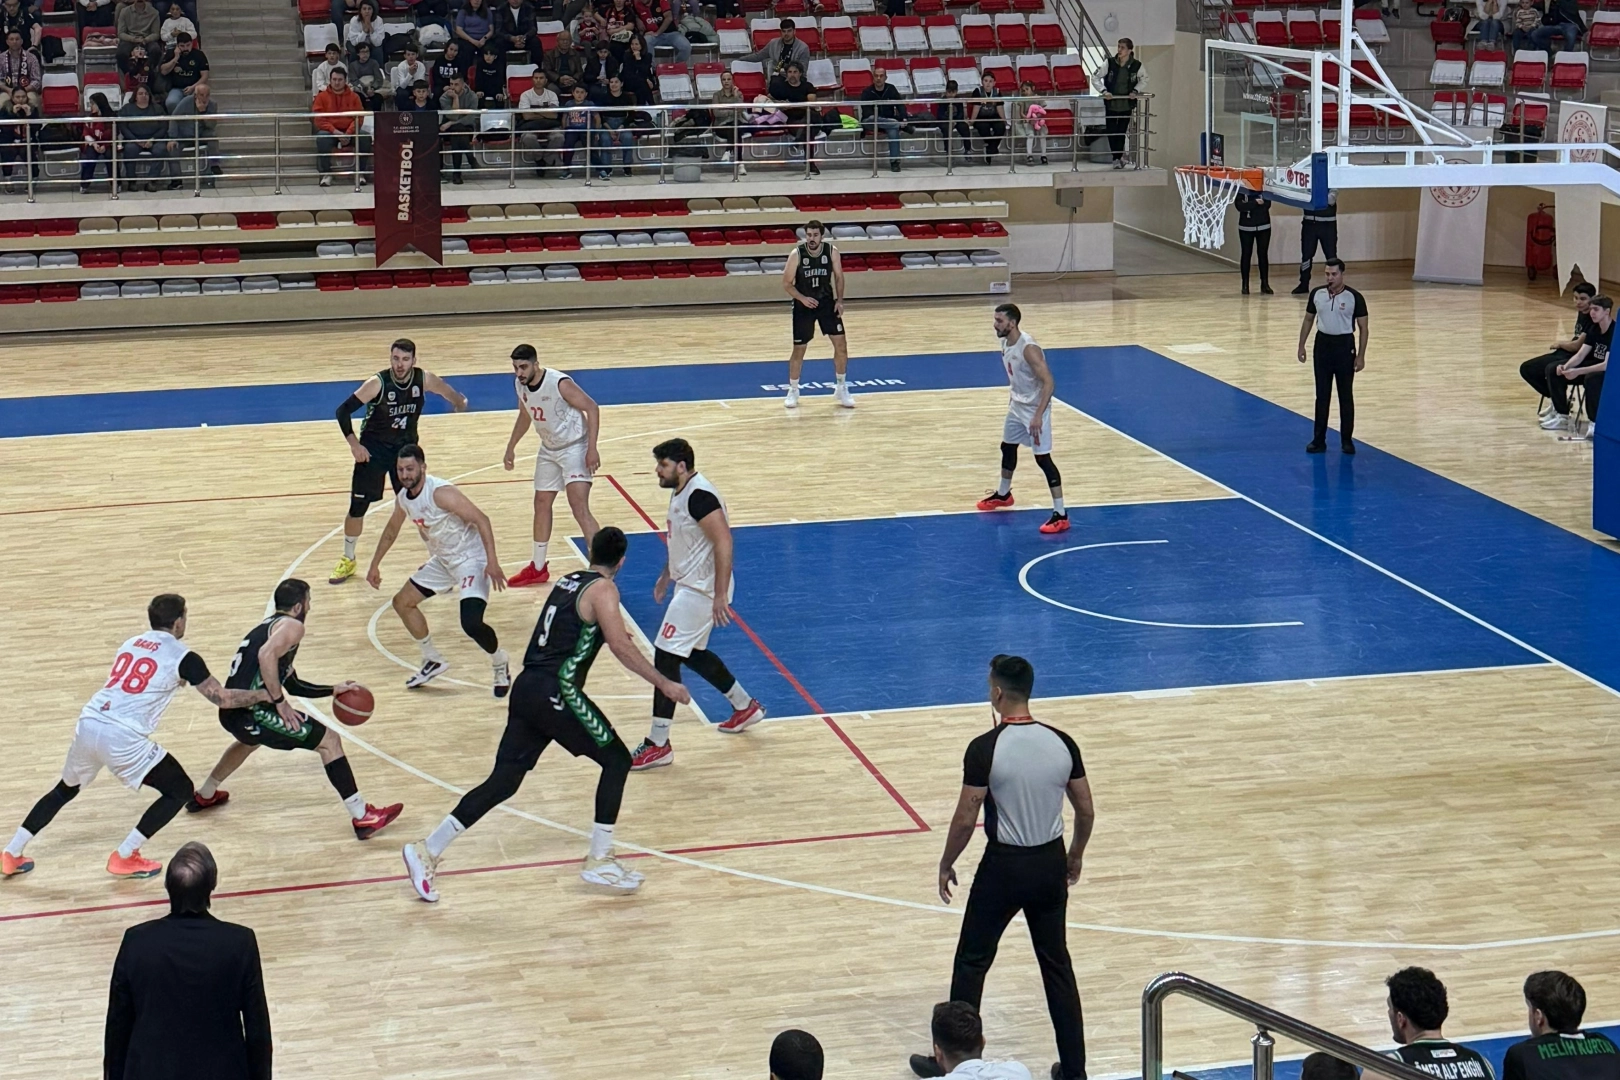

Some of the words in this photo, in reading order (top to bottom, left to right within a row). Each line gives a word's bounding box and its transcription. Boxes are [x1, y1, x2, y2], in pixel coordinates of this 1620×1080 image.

[439, 66, 458, 76] BEST
[397, 140, 415, 221] BASKETBOL
[1293, 171, 1310, 188] TBF
[811, 277, 820, 288] 11
[530, 406, 547, 422] 22
[391, 416, 408, 430] 24
[461, 575, 475, 589] 27
[538, 604, 557, 647] 9
[661, 622, 677, 640] 10
[104, 651, 158, 695] 98
[1440, 1061, 1459, 1080] ALP
[1456, 1057, 1486, 1079] ENGİN
